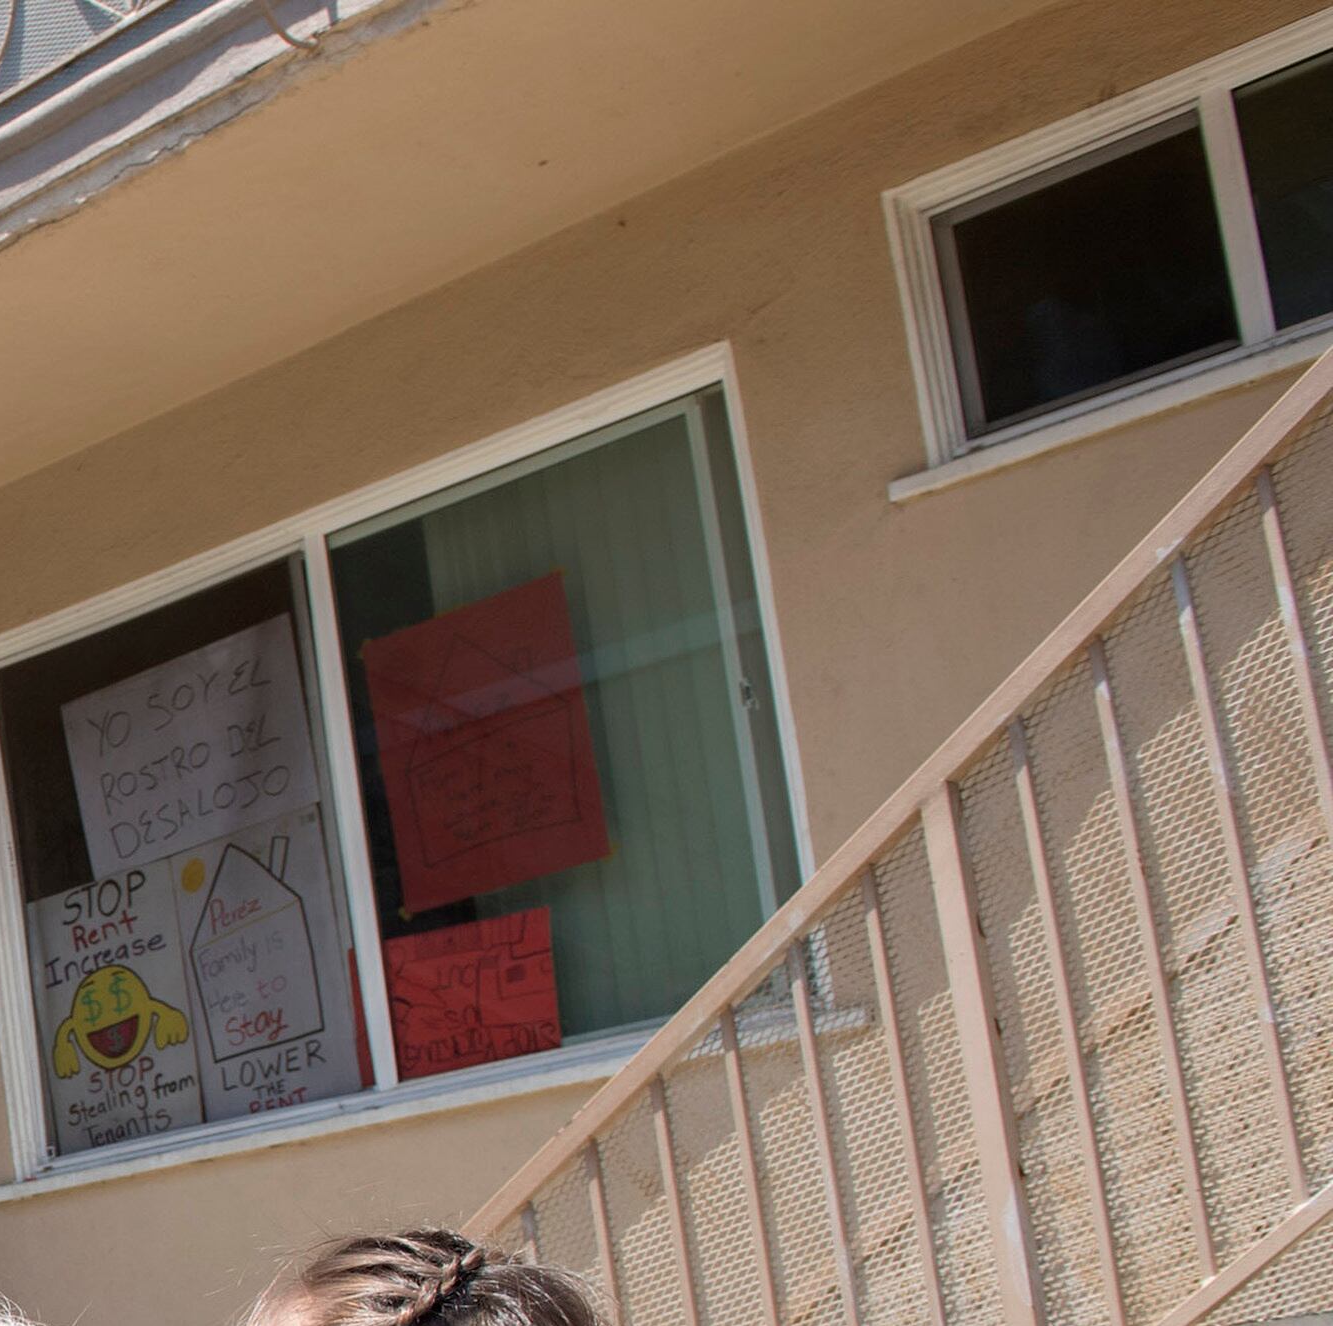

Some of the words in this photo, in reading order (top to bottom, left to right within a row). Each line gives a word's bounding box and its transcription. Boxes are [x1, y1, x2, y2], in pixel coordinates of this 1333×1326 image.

[85, 709, 132, 758] YO
[146, 671, 220, 731] SOY
[227, 656, 272, 695] EL
[99, 741, 211, 816] ROSTRO
[227, 713, 282, 757] DEL
[110, 764, 291, 859] DESALOJO
[62, 869, 147, 926] STOP
[209, 897, 262, 936] Perez
[71, 909, 138, 953] Rent
[44, 933, 167, 990] Increase
[198, 935, 258, 983] Family
[256, 975, 288, 999] to
[224, 1007, 289, 1047] Stay
[87, 1056, 155, 1094] STOP
[220, 1038, 328, 1092] LOWER
[252, 1078, 286, 1100] THE
[68, 1084, 149, 1127] Stealing
[152, 1072, 197, 1099] from
[85, 1108, 173, 1148] Tenants
